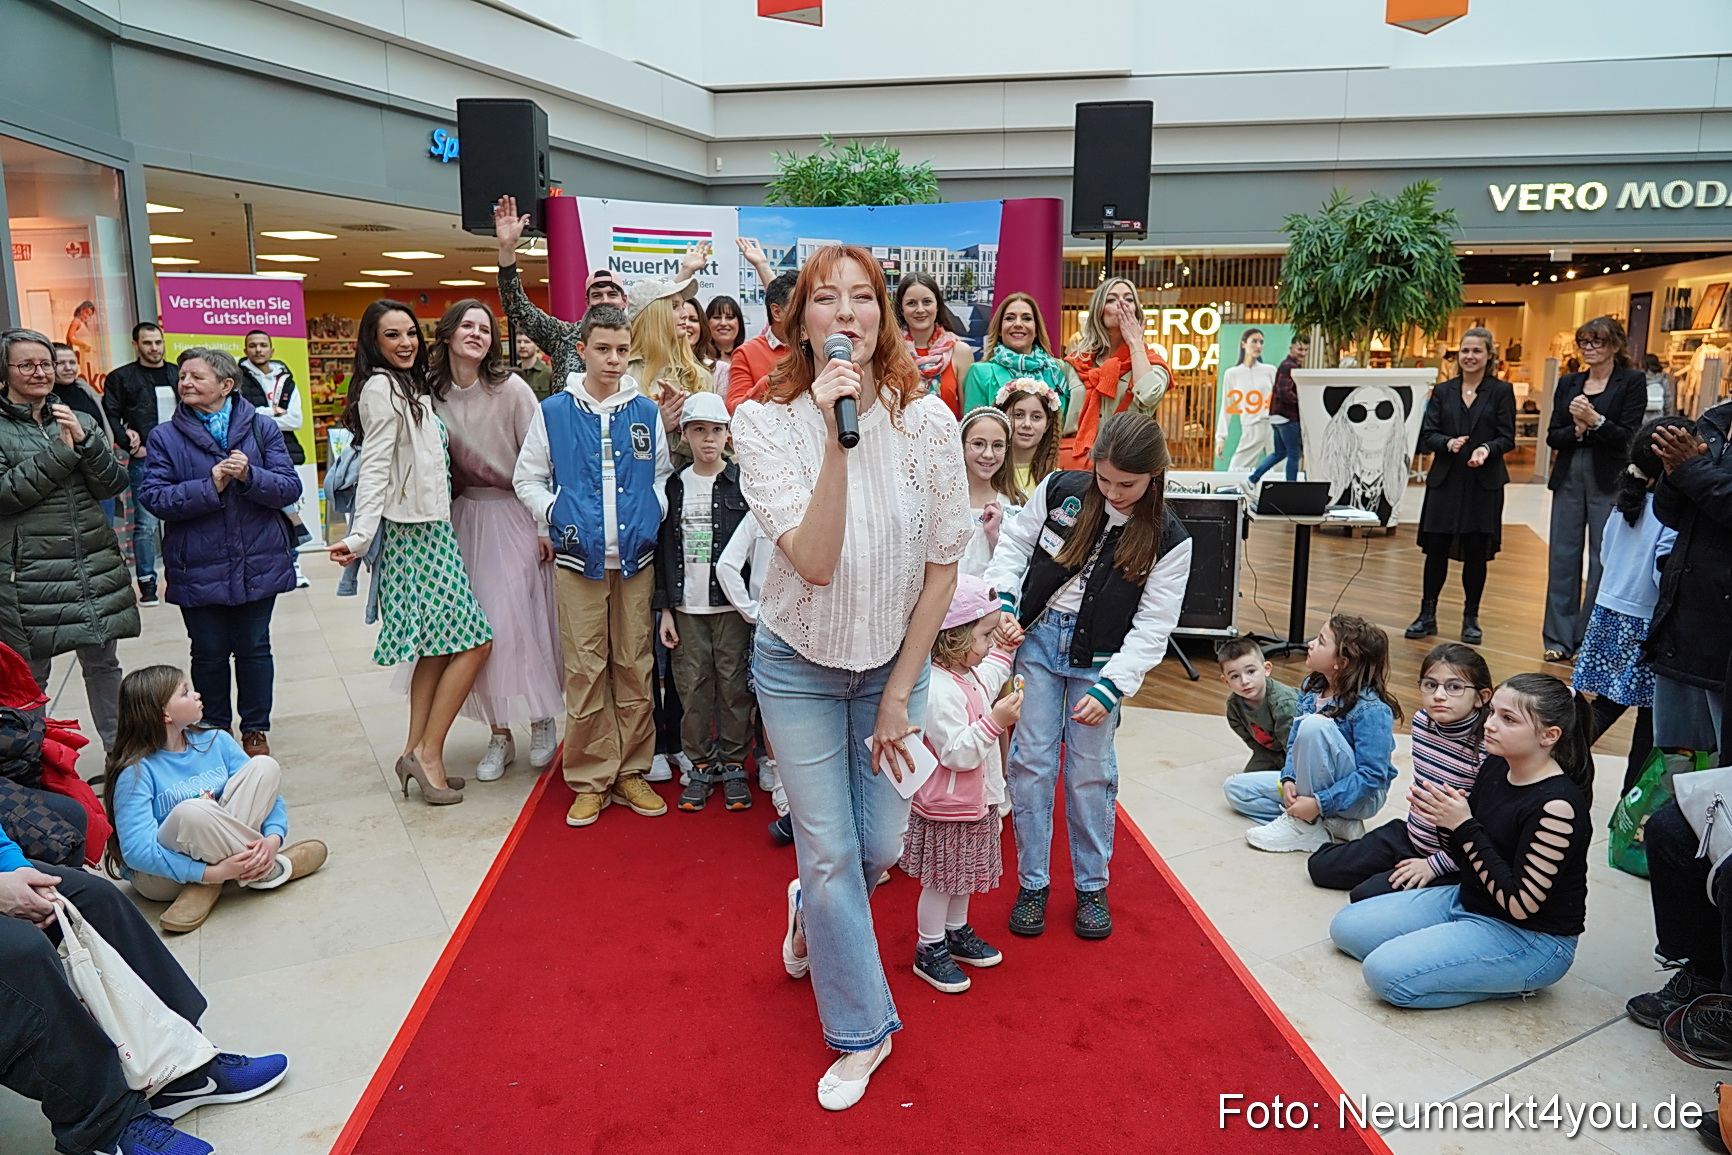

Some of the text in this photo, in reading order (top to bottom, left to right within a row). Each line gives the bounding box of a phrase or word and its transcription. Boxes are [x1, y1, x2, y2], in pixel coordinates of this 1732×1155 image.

[1488, 179, 1732, 212] VERO MOD
[608, 256, 719, 276] NeuerMkt
[169, 295, 291, 310] Verschenken Sie
[203, 311, 292, 325] Gutscheine!
[1143, 307, 1222, 336] ERO
